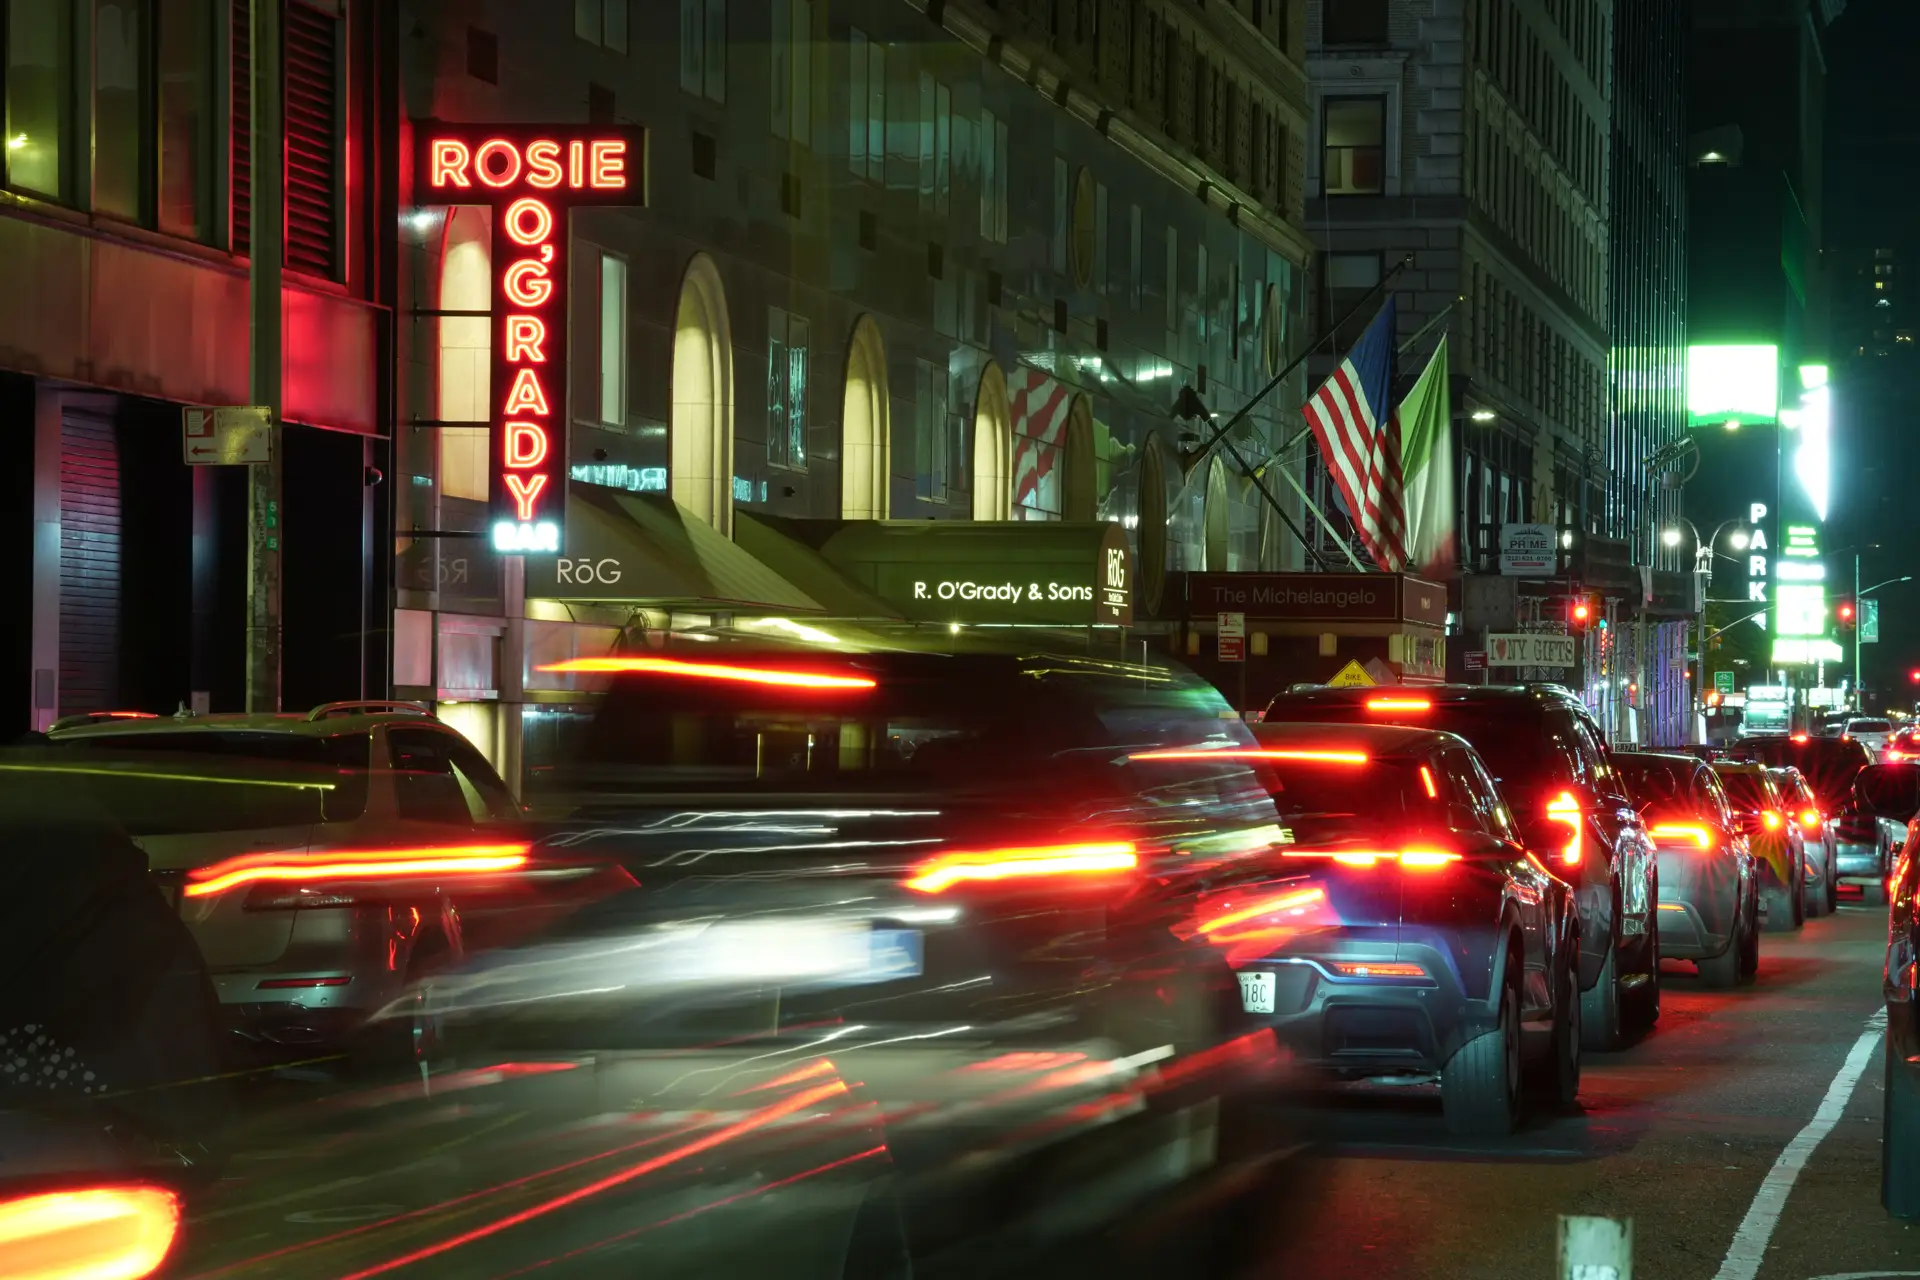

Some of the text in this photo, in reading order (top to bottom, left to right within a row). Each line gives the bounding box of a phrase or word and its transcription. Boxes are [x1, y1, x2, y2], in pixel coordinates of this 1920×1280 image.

[431, 138, 627, 188] ROSIE
[503, 197, 554, 520] O'GRADY
[492, 521, 559, 551] BAR
[1510, 540, 1548, 549] PRIME
[1749, 503, 1767, 602] PARK
[557, 558, 622, 584] RōG
[914, 581, 931, 600] R.
[938, 581, 1022, 604] O'Grady
[1028, 582, 1043, 601] &
[1048, 582, 1093, 601] Sons
[1213, 586, 1376, 608] The Michelangelo
[1507, 638, 1527, 661] NY
[1534, 639, 1574, 663] GIFTS
[1345, 673, 1362, 681] BIKE
